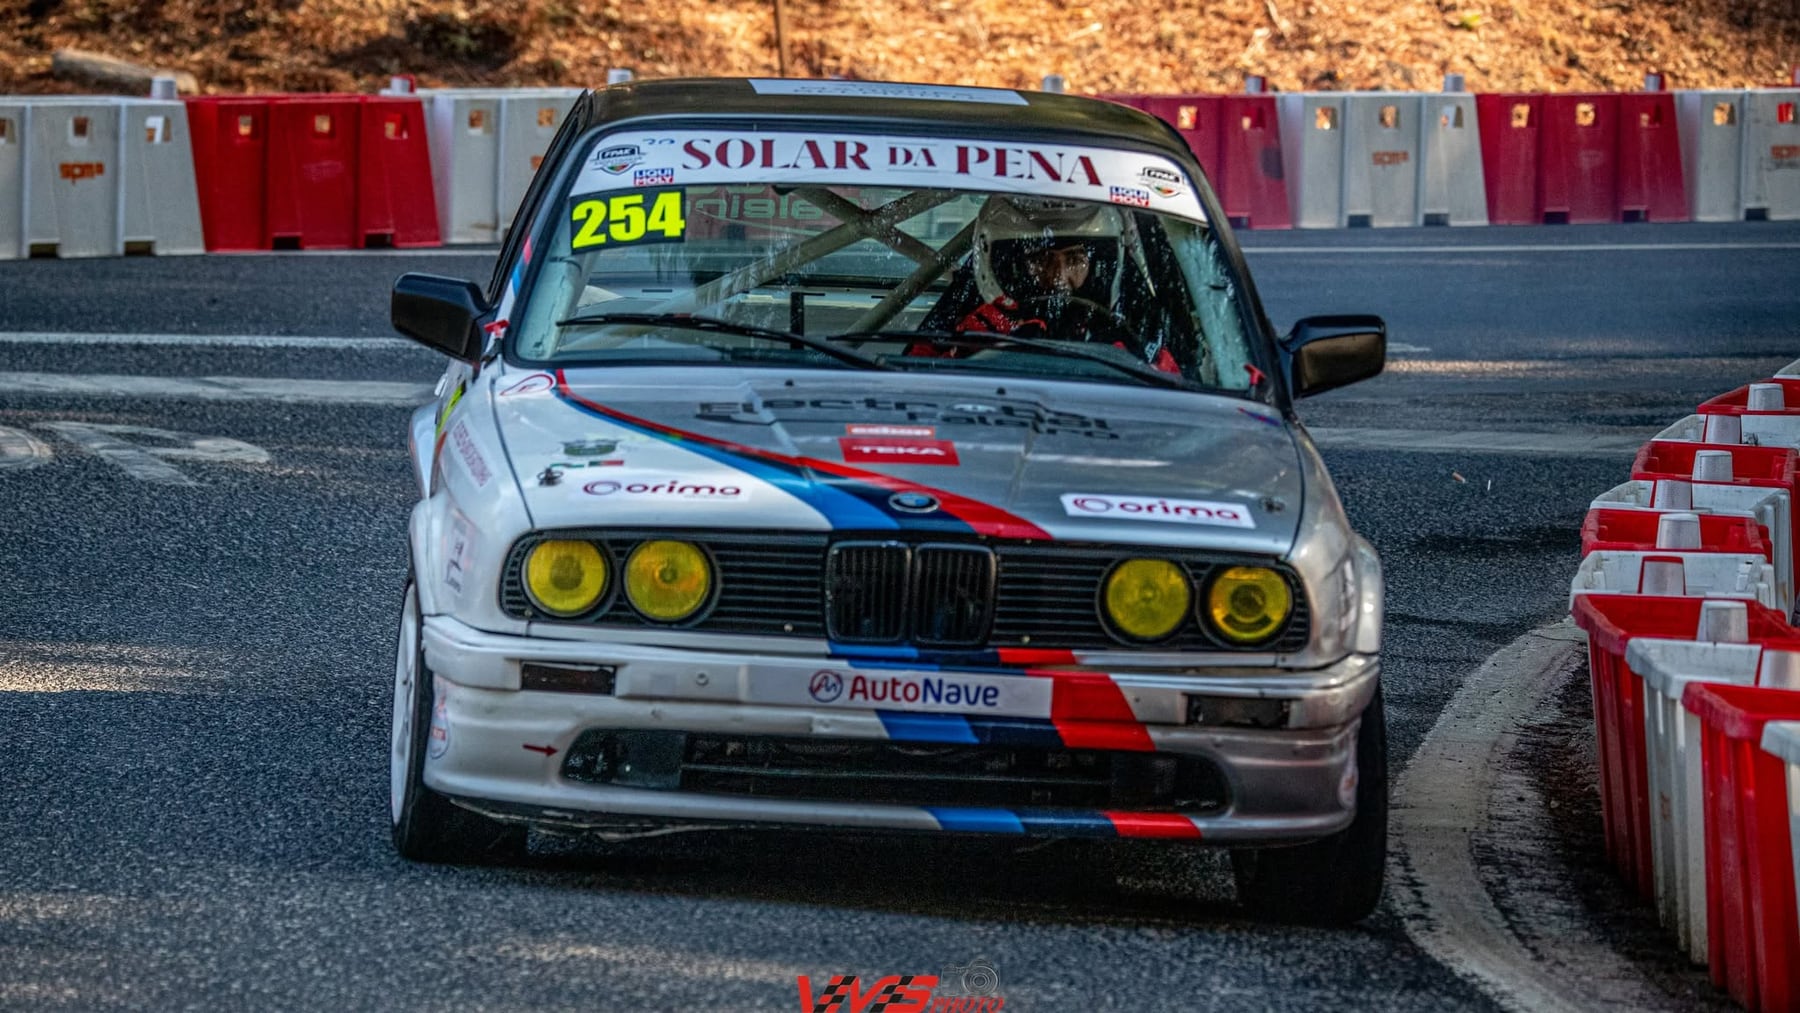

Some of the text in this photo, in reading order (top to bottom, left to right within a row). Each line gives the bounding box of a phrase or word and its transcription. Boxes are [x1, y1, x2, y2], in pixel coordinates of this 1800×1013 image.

[682, 138, 1103, 187] SOLAR DA PENA
[635, 168, 674, 178] LIQUI
[635, 177, 674, 187] MOLY
[1112, 195, 1149, 208] MOLY
[572, 191, 685, 249] 254
[852, 445, 946, 456] TEKA
[626, 480, 741, 495] orima
[1119, 500, 1239, 520] orima
[849, 675, 999, 707] AutoNave
